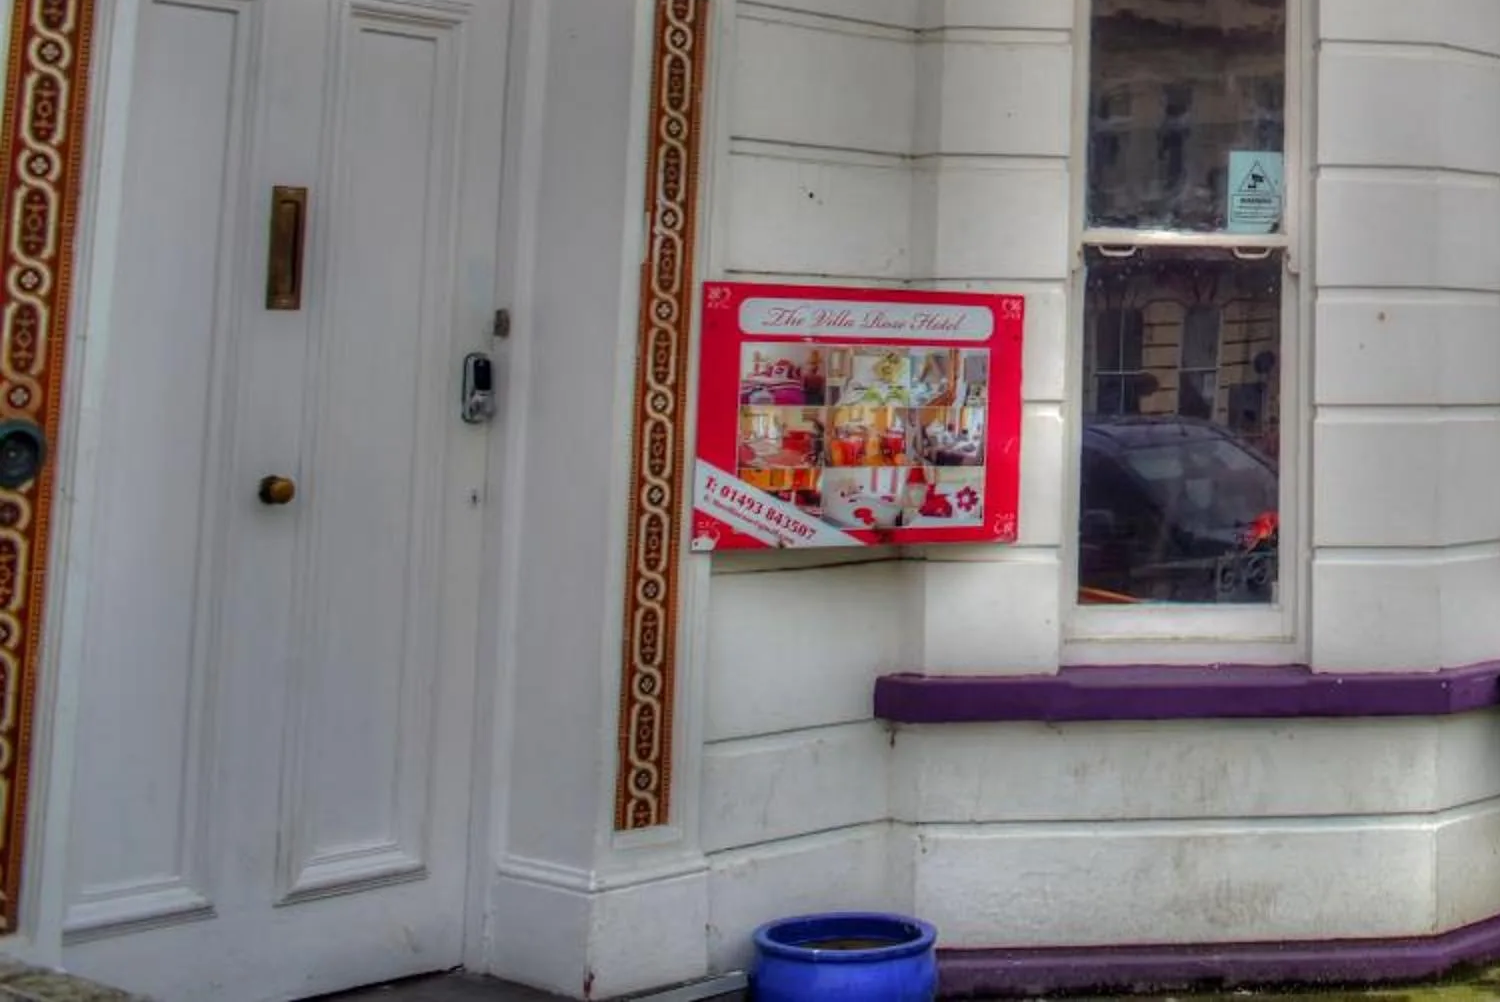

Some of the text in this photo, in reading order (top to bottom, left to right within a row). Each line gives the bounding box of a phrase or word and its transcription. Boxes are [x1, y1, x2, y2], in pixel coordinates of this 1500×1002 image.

[761, 306, 806, 327] The
[812, 308, 856, 327] Villa
[909, 312, 968, 331] Hotel
[719, 484, 764, 515] 01493
